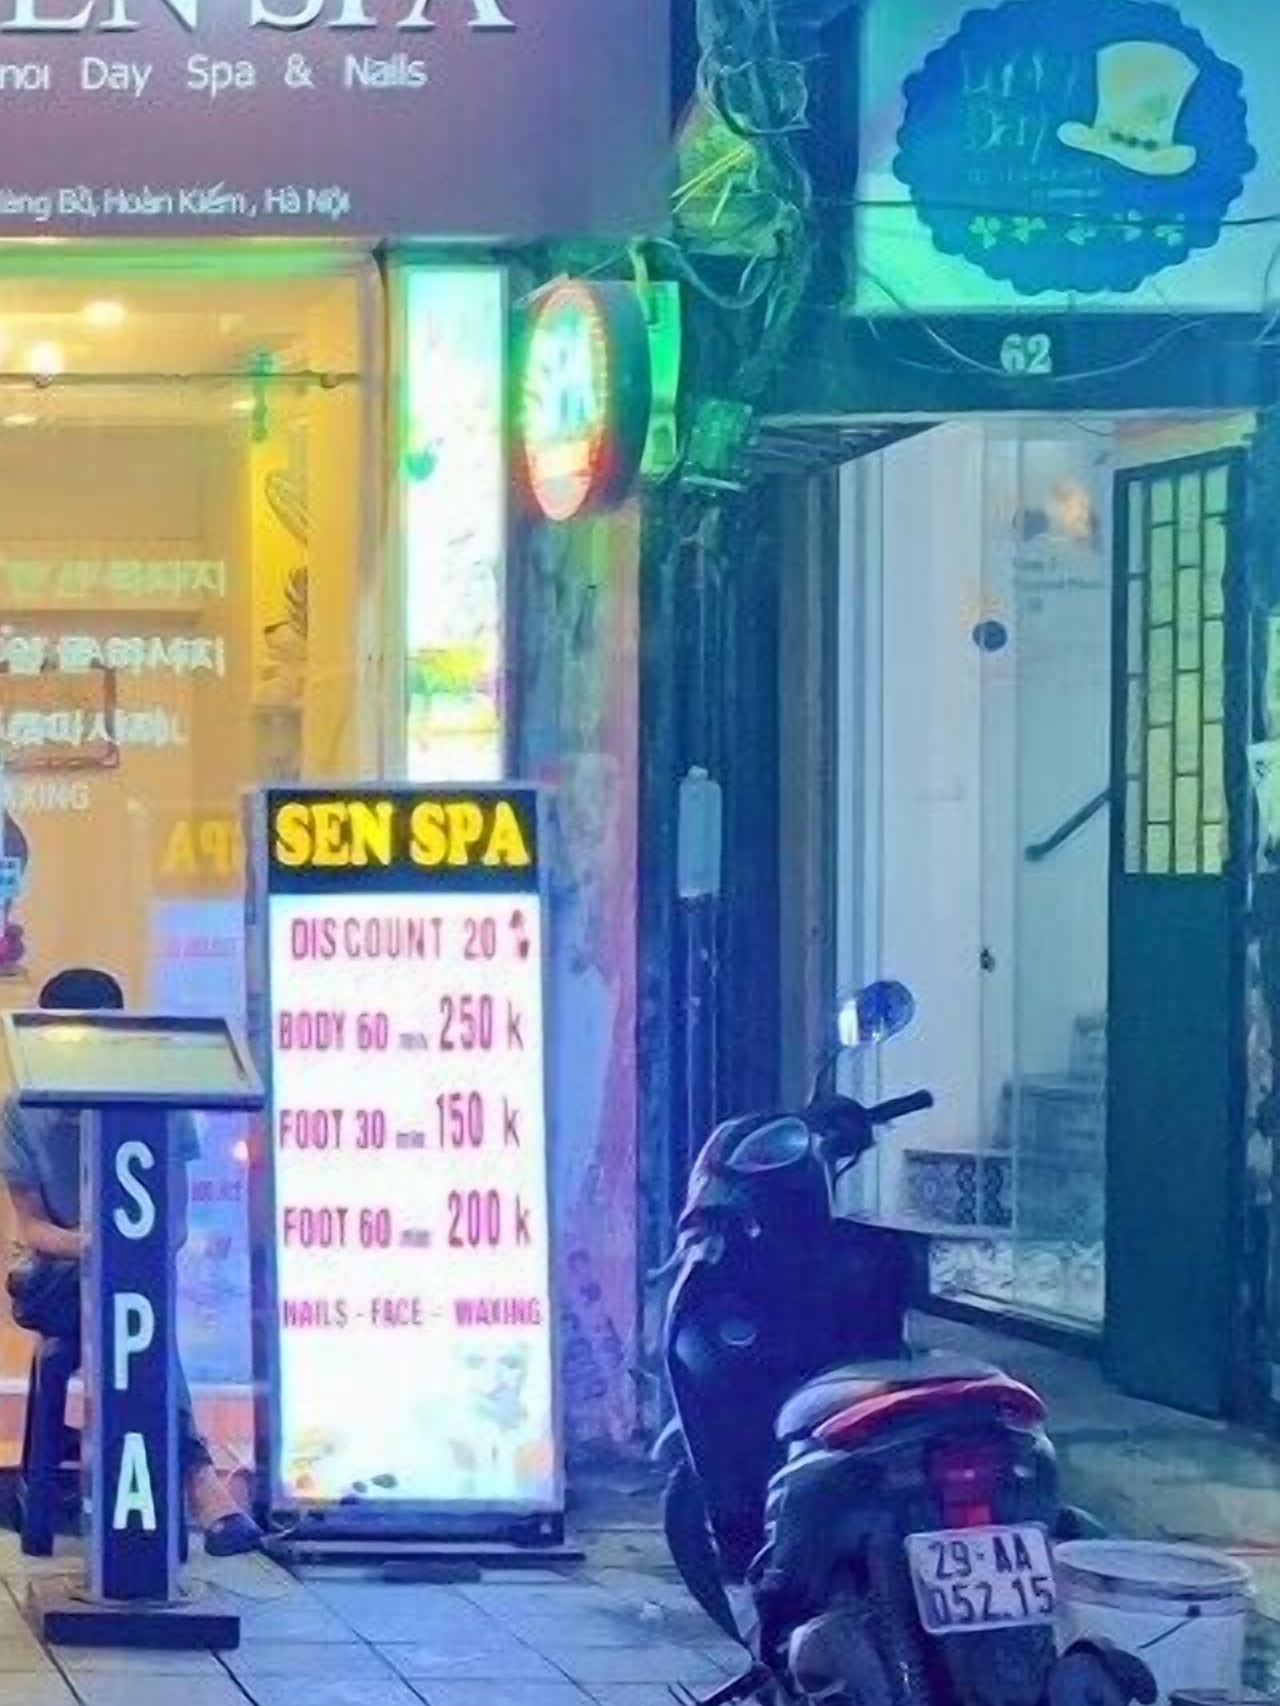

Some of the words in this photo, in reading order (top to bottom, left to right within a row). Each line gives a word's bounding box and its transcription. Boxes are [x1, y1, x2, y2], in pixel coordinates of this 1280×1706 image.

[80, 56, 153, 97] Day
[186, 53, 256, 98] Spa
[283, 52, 315, 89] &
[344, 53, 429, 90] Nails
[999, 331, 1053, 375] 62
[275, 801, 394, 867] SEN
[409, 800, 531, 867] SPA
[291, 916, 443, 961] DISCOUNT
[278, 1009, 346, 1051] BODY
[356, 1010, 389, 1051] 60
[439, 993, 494, 1052] 250
[279, 1109, 343, 1149] FOOT
[355, 1108, 387, 1150] 30
[436, 1090, 485, 1149] 150
[283, 1206, 349, 1249] FOOT
[358, 1206, 392, 1249] 60
[447, 1188, 501, 1248] 200
[283, 1298, 349, 1328] NAILS
[370, 1296, 424, 1327] FACE
[453, 1297, 542, 1327] WAXING
